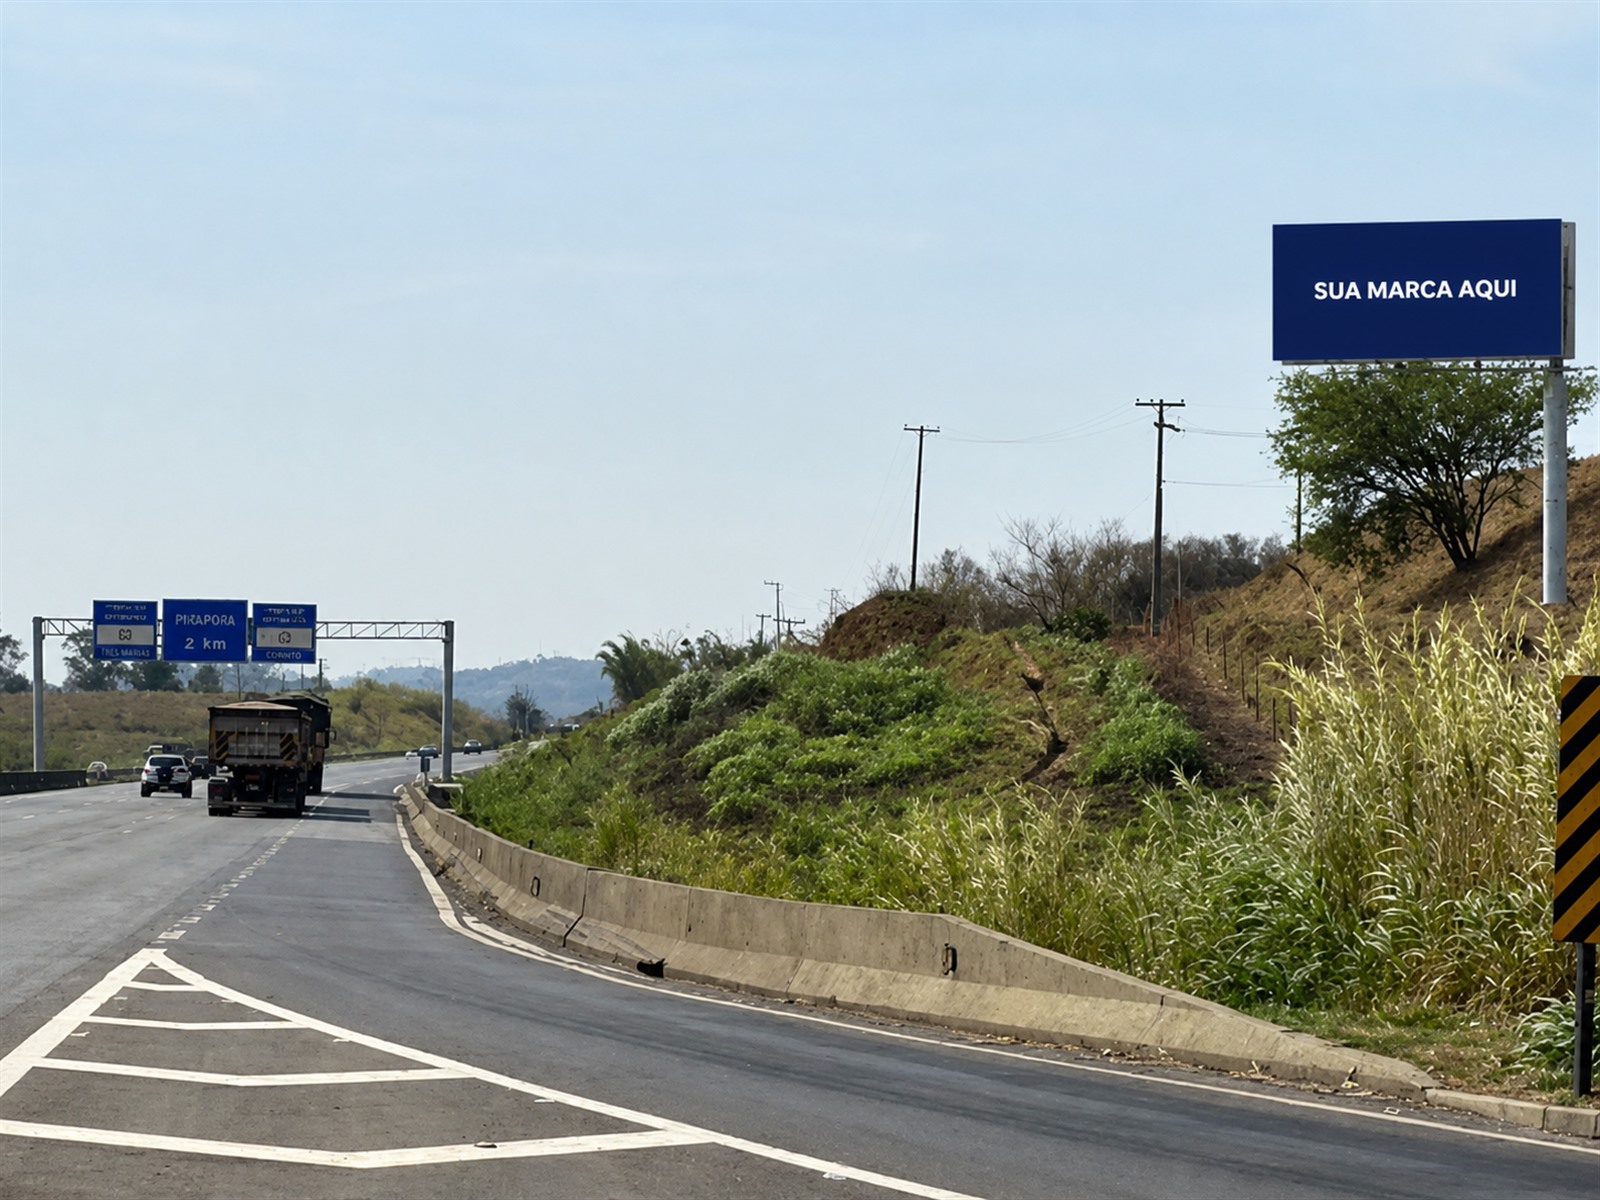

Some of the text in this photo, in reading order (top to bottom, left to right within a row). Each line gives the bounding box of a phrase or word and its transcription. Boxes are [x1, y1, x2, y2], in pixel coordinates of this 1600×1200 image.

[1314, 279, 1517, 301] SUA MARCA AQUI
[175, 614, 236, 626] PIRAPORA
[184, 637, 226, 650] 2 km
